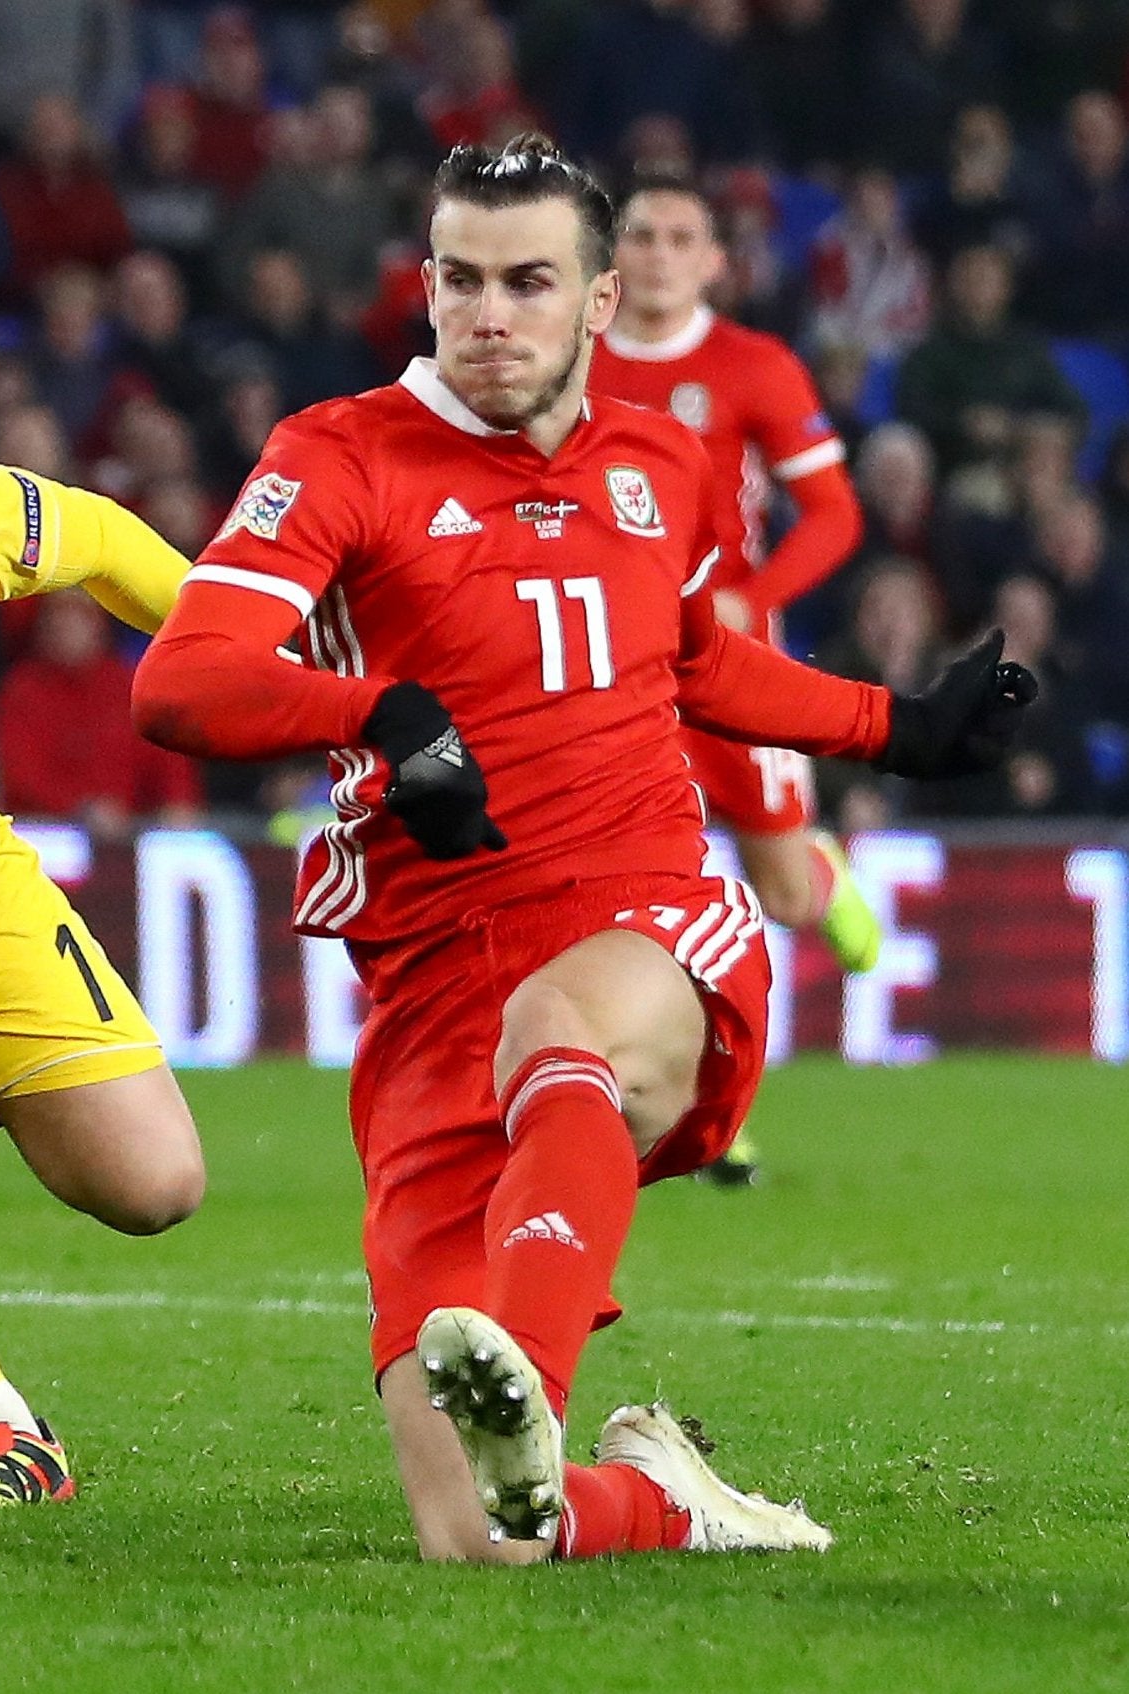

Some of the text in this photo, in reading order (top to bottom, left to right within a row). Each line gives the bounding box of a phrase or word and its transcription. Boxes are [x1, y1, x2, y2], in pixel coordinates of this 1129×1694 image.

[427, 520, 483, 538] adidas
[515, 576, 615, 692] 11
[55, 924, 114, 1022] 1
